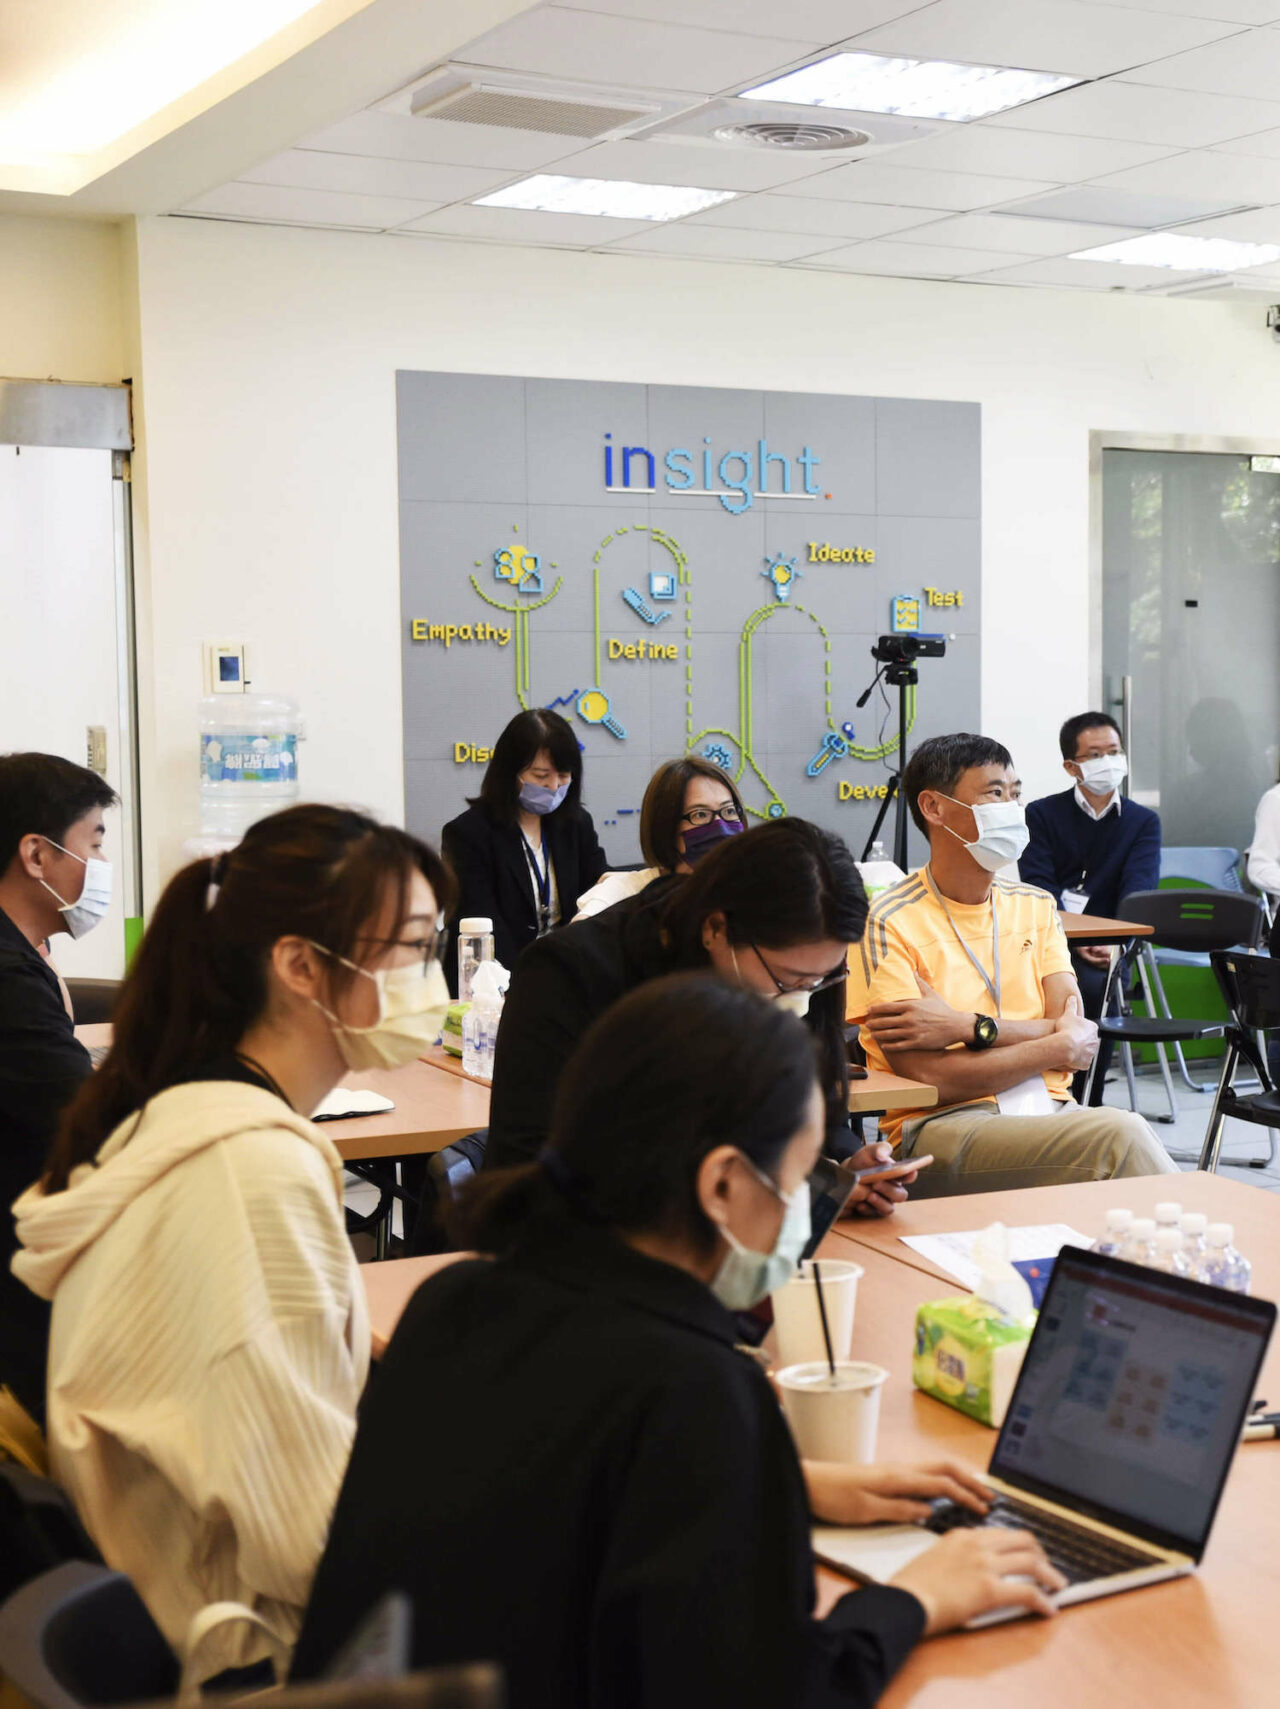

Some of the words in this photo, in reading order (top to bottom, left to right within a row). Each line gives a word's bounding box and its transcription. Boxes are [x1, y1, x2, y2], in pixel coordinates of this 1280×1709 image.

[808, 541, 876, 564] Ideate
[924, 586, 965, 608] Test
[411, 618, 512, 648] Empathy
[608, 638, 679, 660] Define
